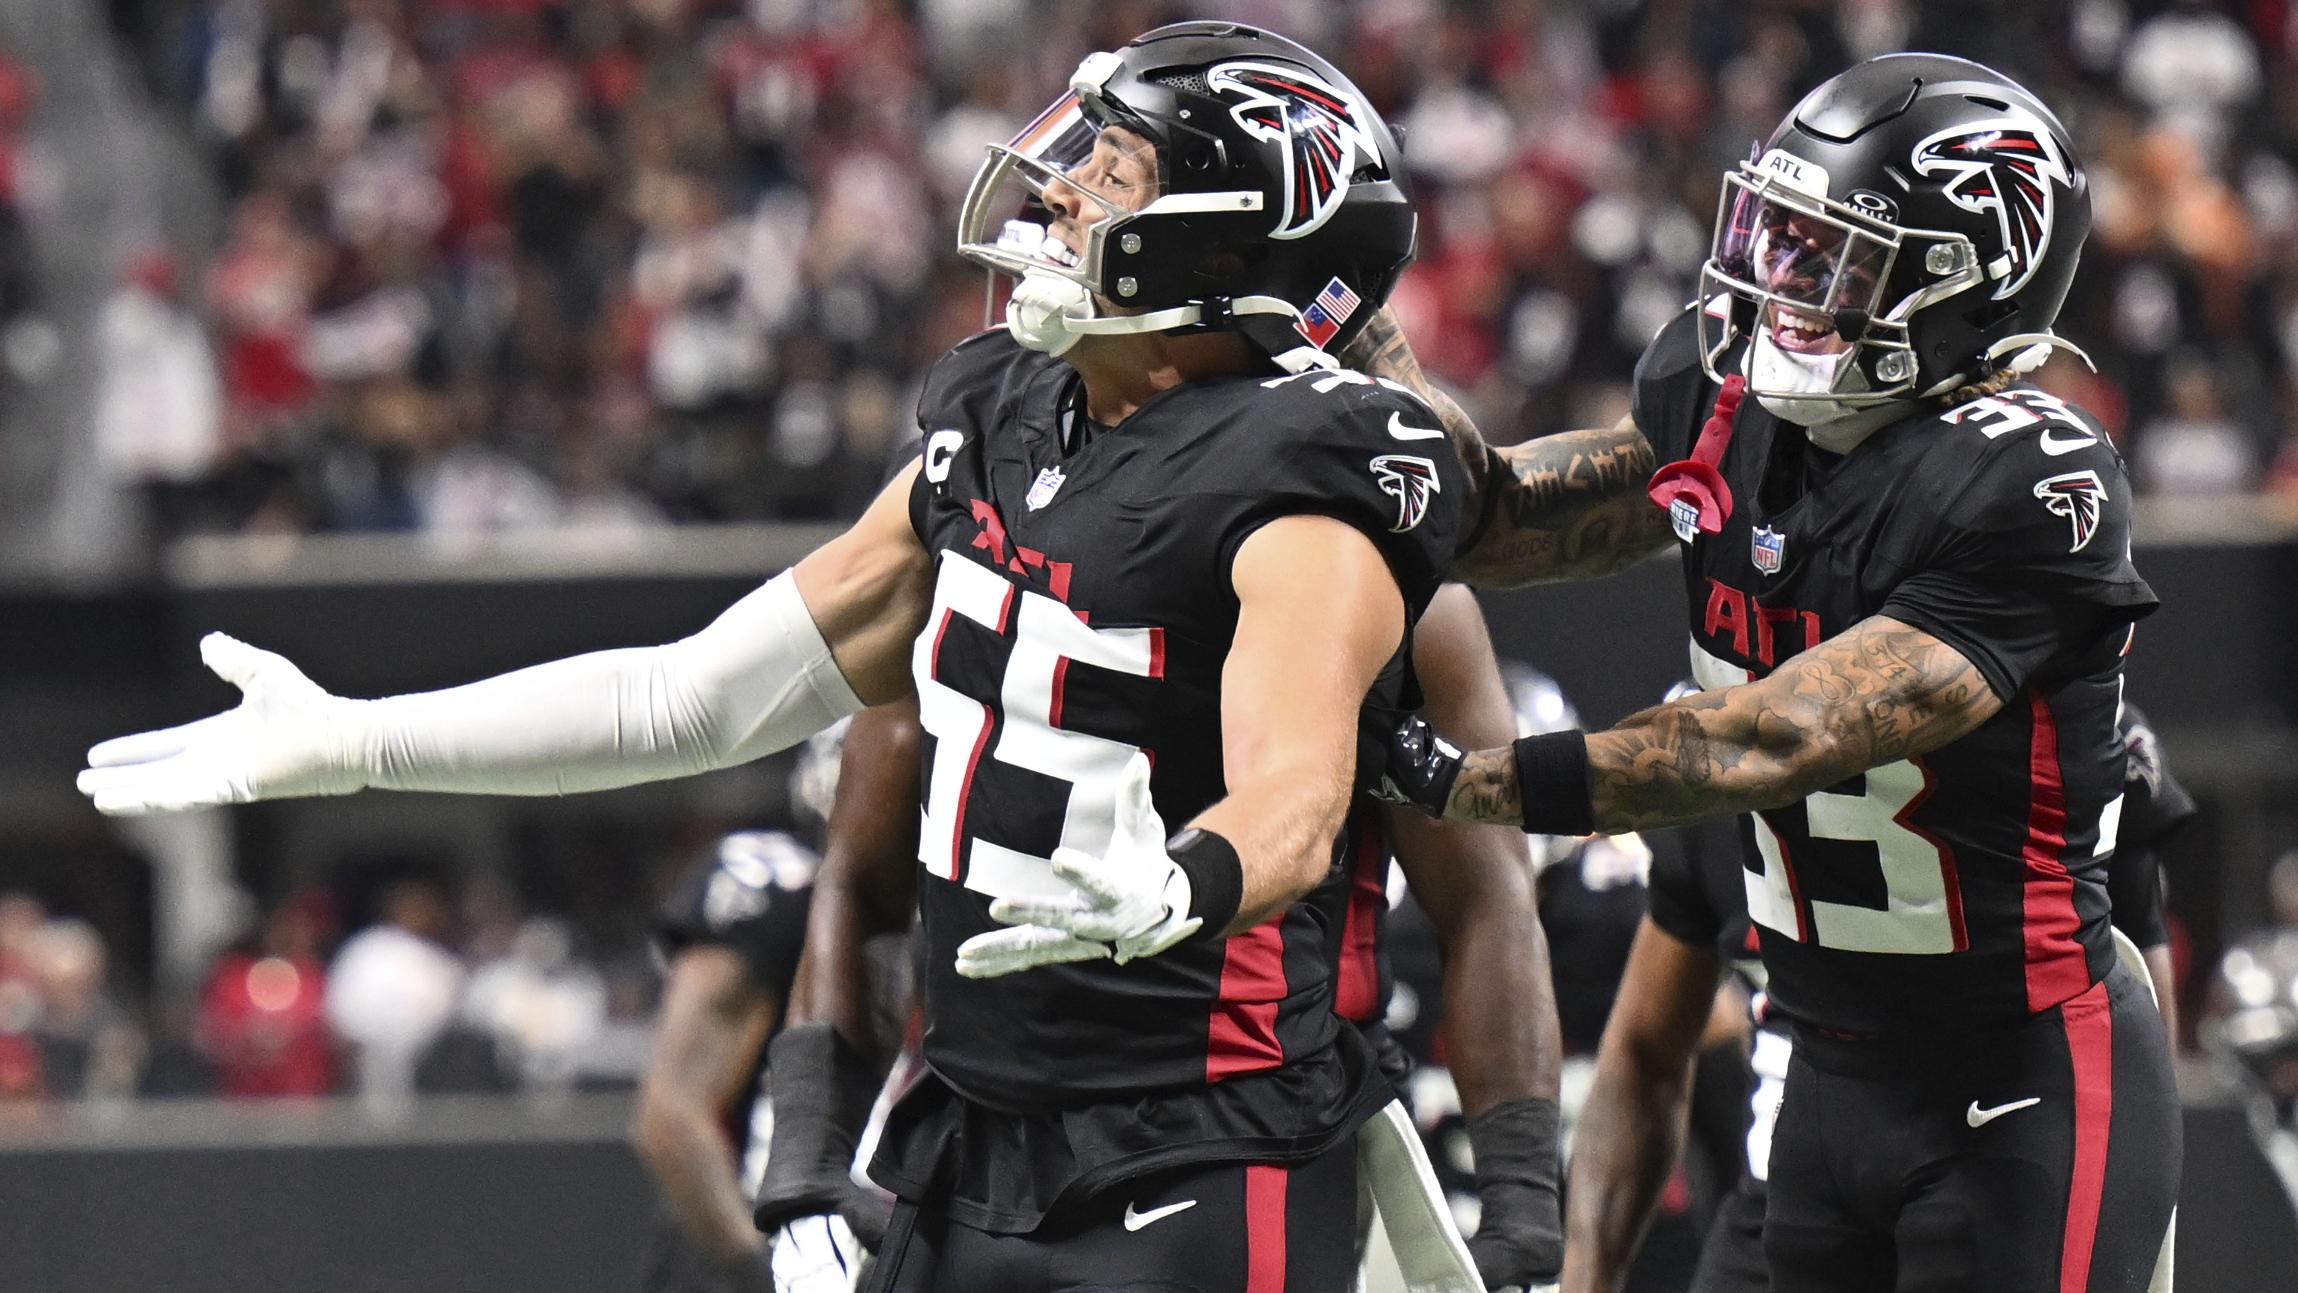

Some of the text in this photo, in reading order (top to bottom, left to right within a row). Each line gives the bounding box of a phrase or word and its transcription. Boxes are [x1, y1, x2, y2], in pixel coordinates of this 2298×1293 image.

[1769, 155, 1803, 181] ATL
[1842, 201, 1894, 222] OAKLEY
[1939, 389, 2097, 440] 33
[925, 429, 964, 483] C
[1755, 549, 1778, 568] NFL
[912, 548, 1166, 902] 55
